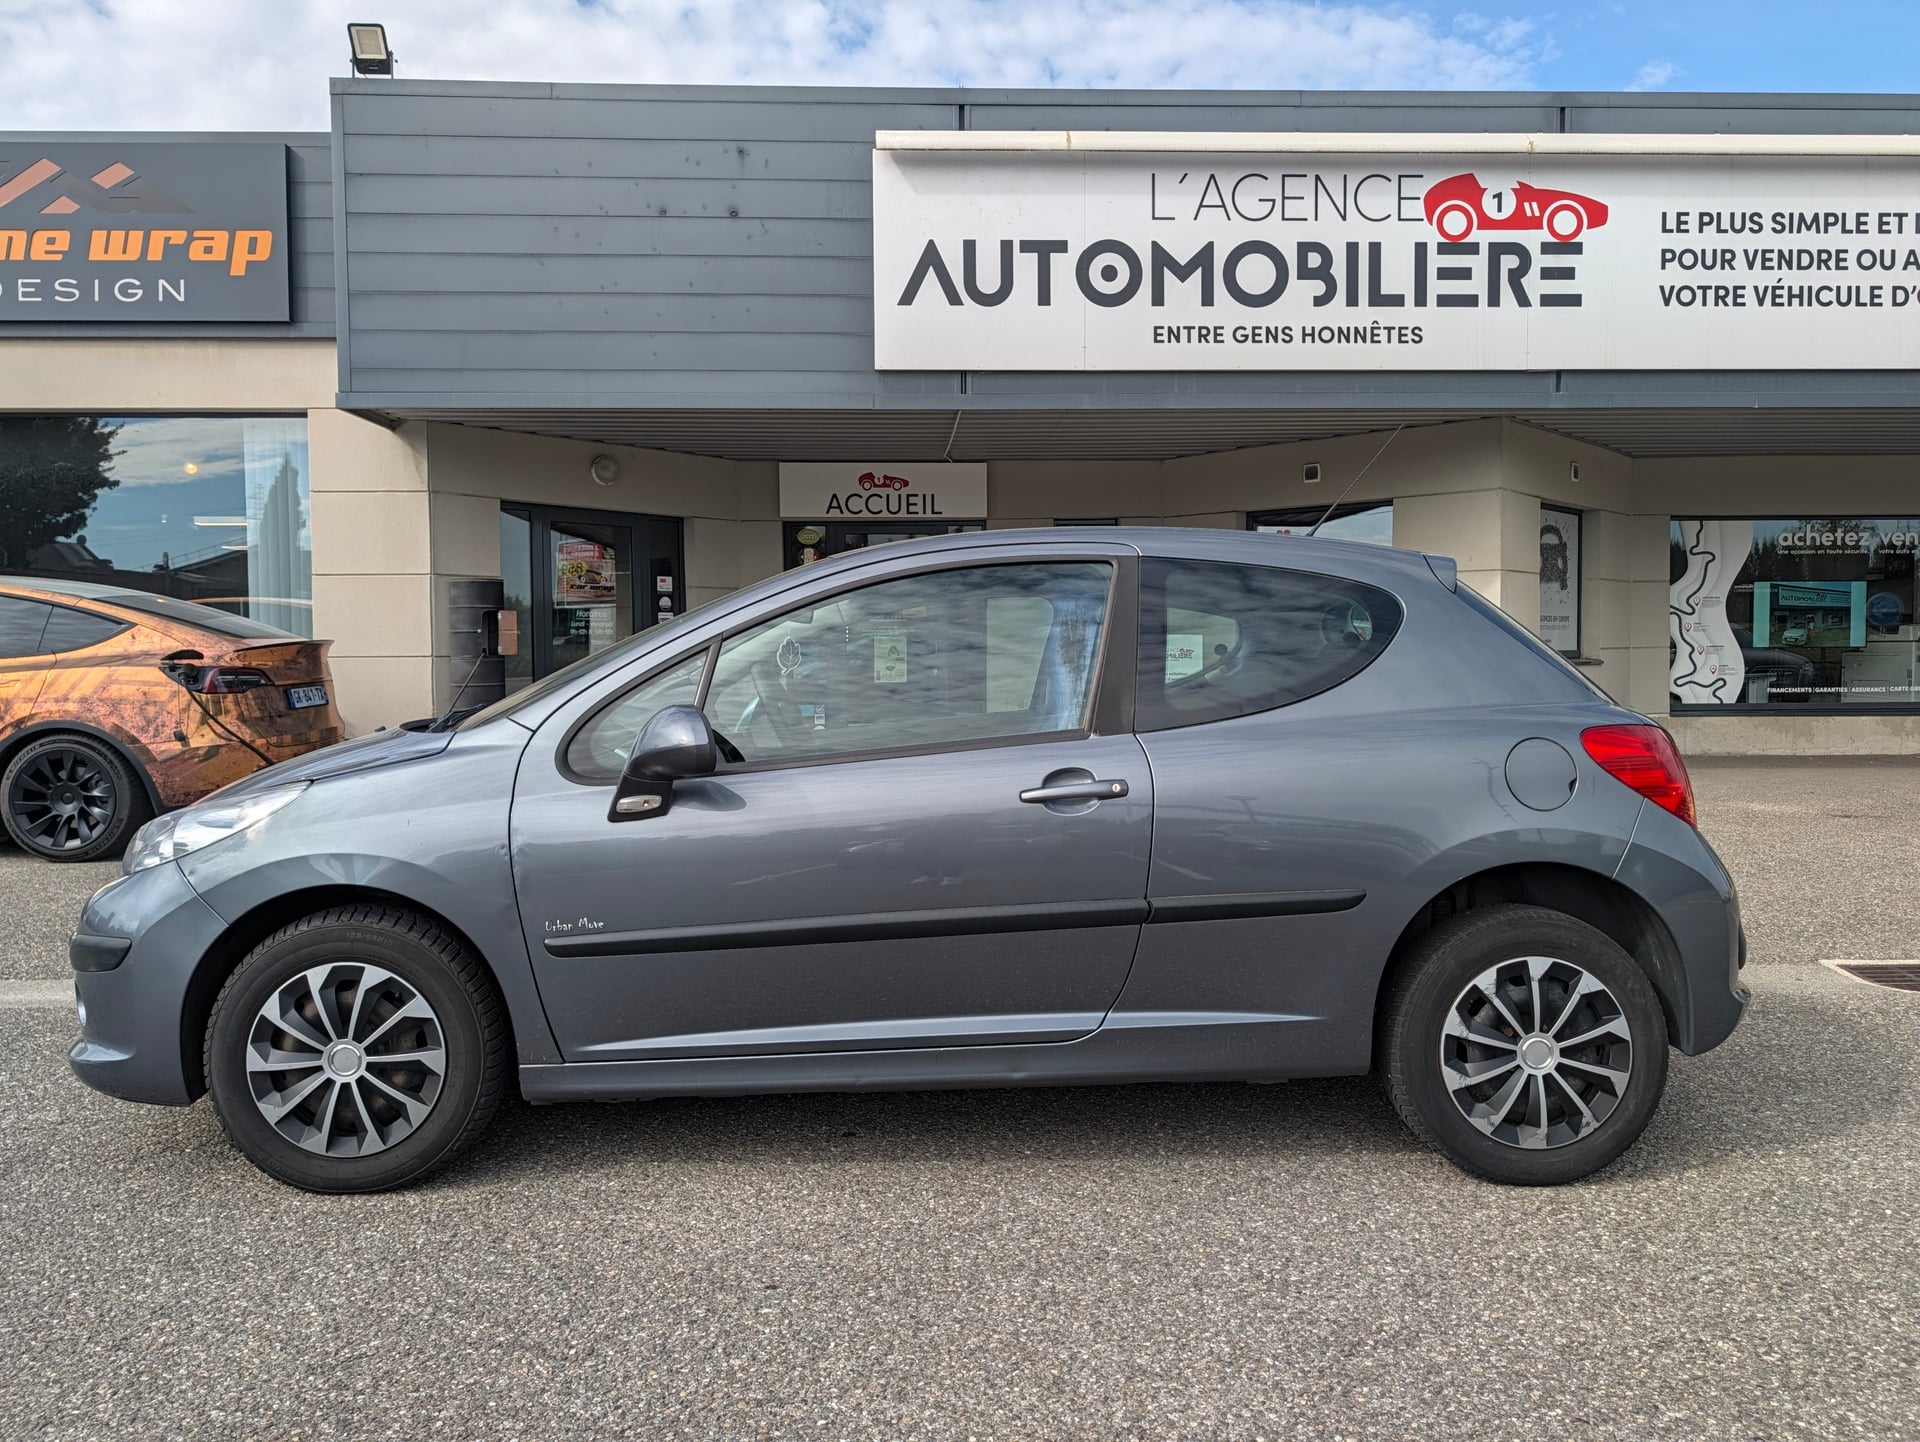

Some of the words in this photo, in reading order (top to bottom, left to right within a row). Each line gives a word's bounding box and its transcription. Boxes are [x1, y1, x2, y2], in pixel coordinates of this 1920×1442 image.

[1151, 173, 1424, 222] L'AGENCE
[1492, 191, 1502, 213] 1
[1661, 211, 1690, 234] LE
[1698, 211, 1764, 234] PLUS
[1771, 211, 1869, 235] SIMPLE
[1877, 212, 1908, 235] ET
[88, 229, 273, 276] wrap
[1660, 248, 1736, 271] POUR
[1743, 248, 1849, 271] VENDRE
[1856, 248, 1896, 271] OU
[897, 239, 1583, 308] AUTOMOBILIERE
[0, 278, 186, 302] ESIGN
[1659, 284, 1746, 308] VOTRE
[1753, 277, 1883, 308] VÉHICULE
[1891, 285, 1920, 308] D'
[1153, 325, 1224, 344] ENTRE
[1232, 325, 1294, 344] GENS
[1302, 320, 1424, 344] HONNÊTES
[825, 493, 943, 515] ACCUEIL
[1778, 523, 1871, 546] achetez
[545, 920, 573, 932] Urban
[578, 917, 605, 930] Move
